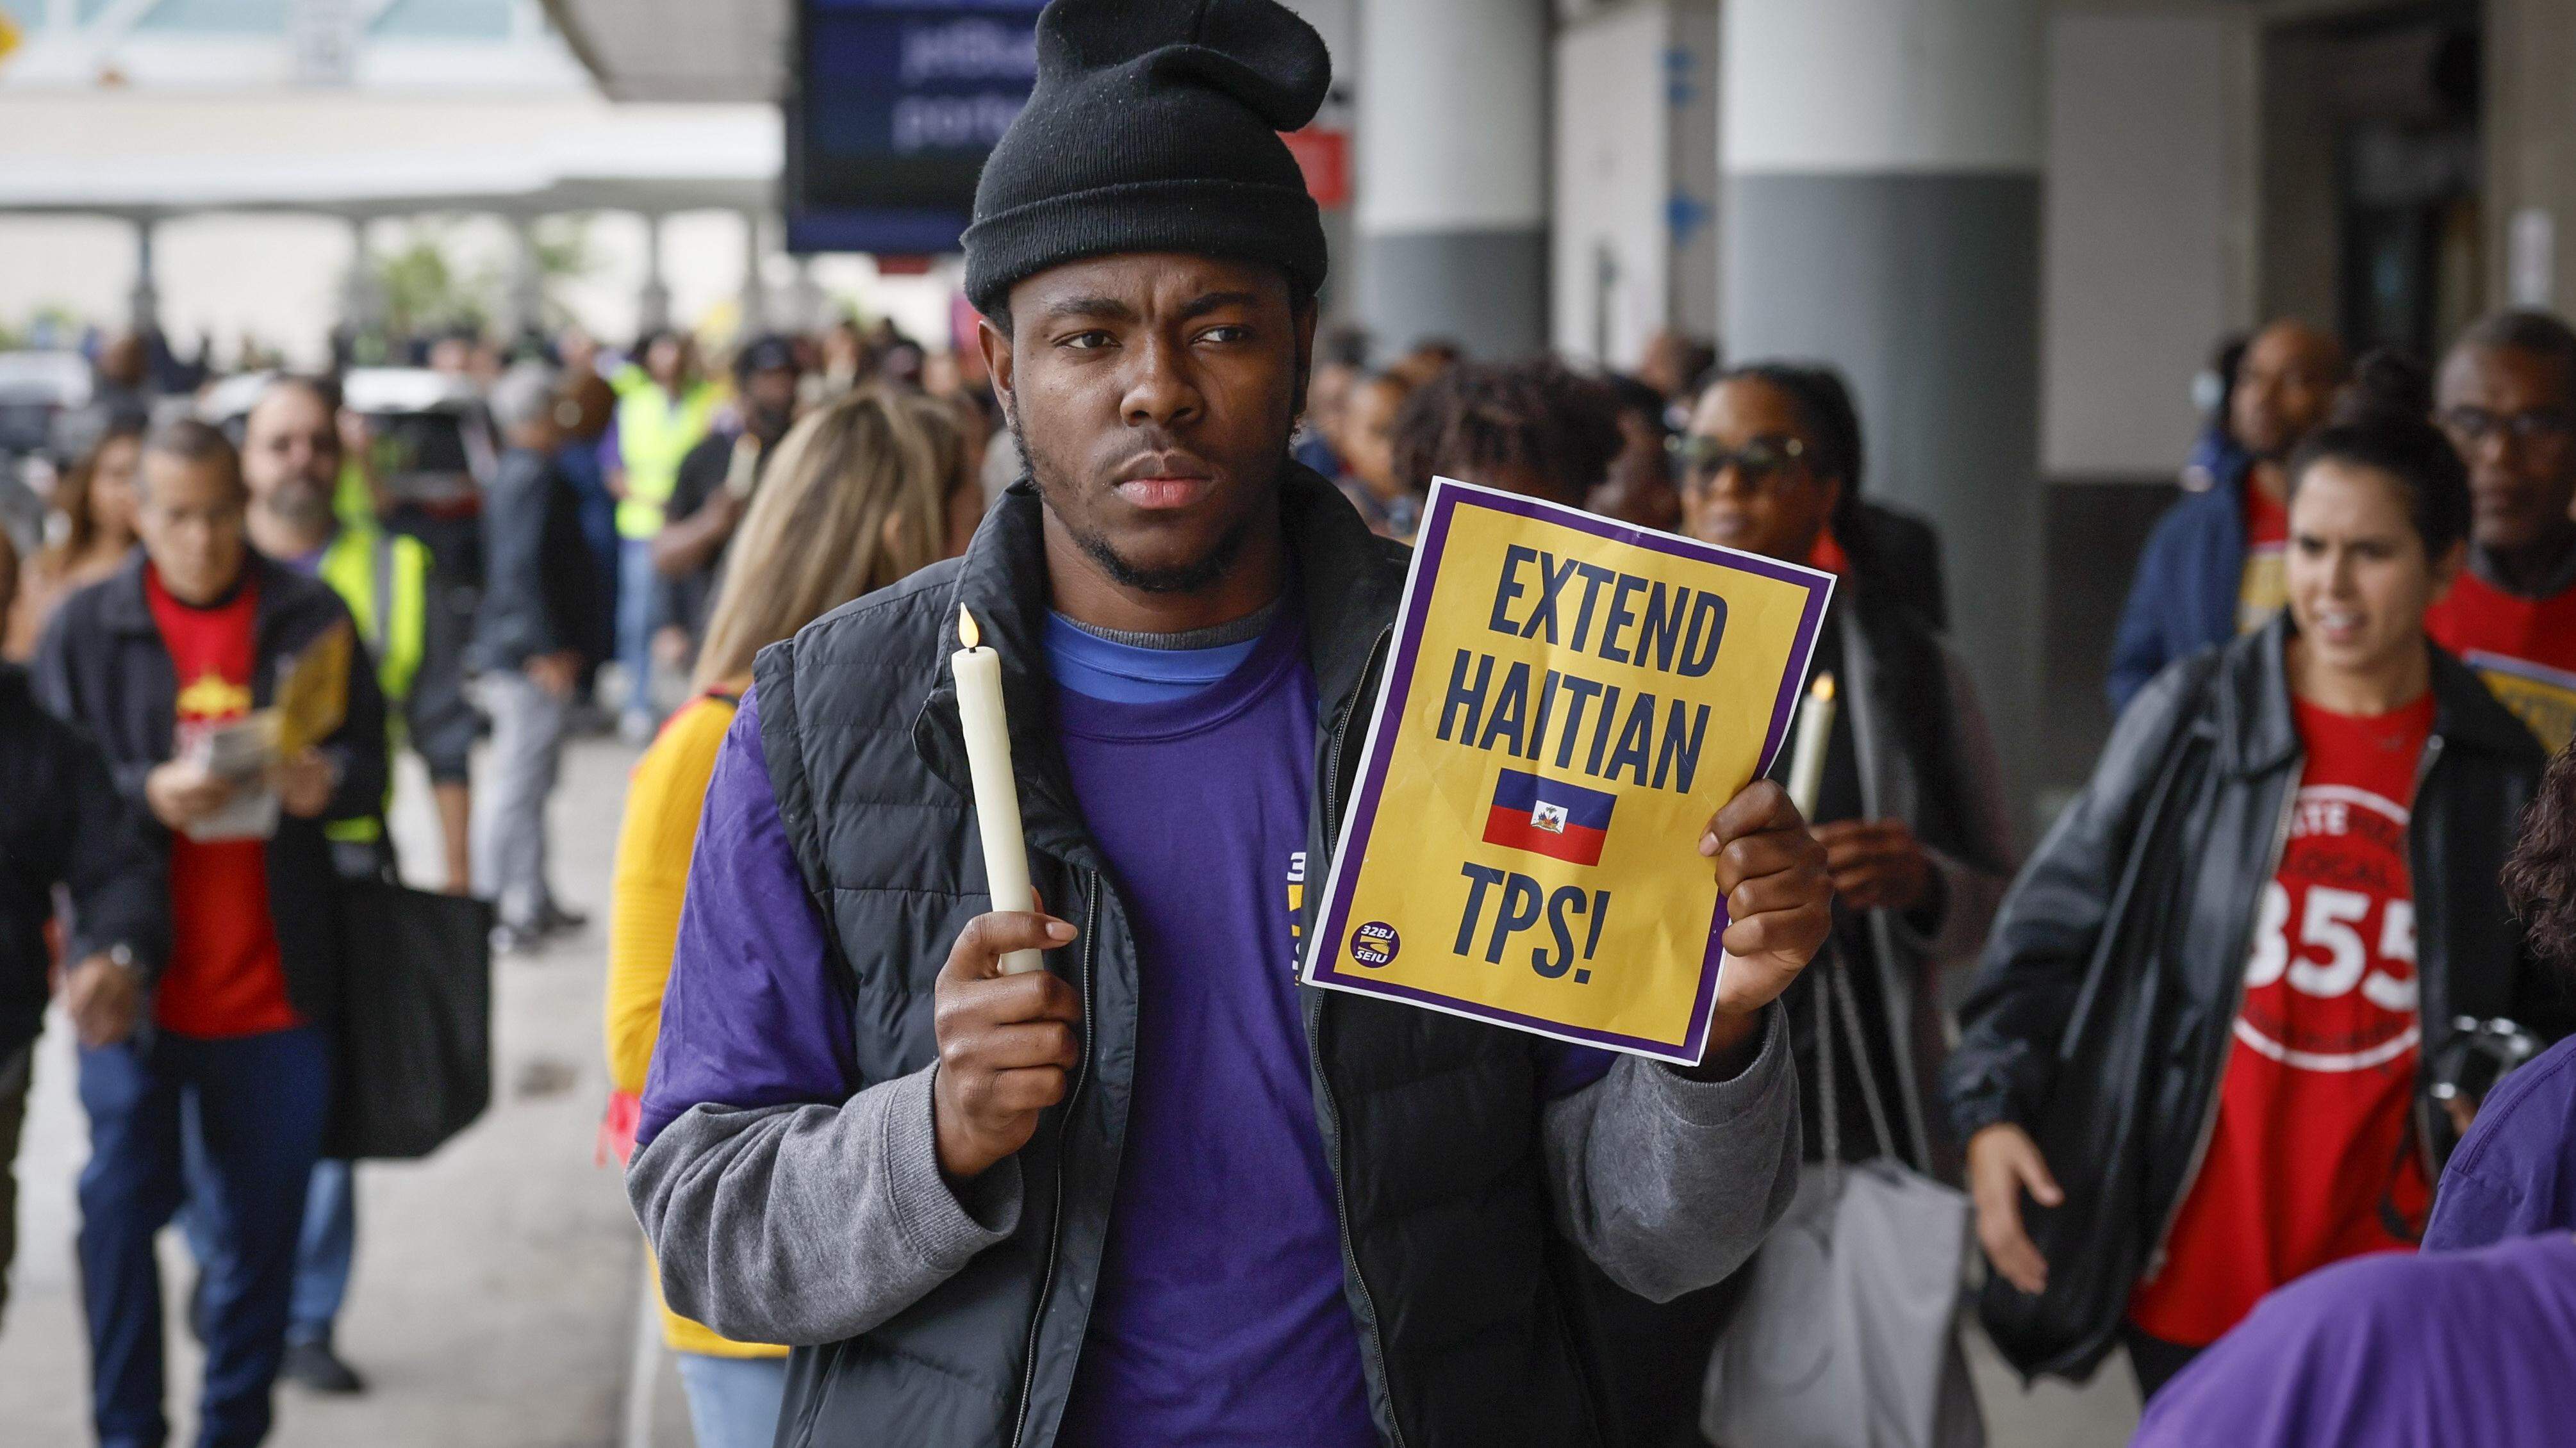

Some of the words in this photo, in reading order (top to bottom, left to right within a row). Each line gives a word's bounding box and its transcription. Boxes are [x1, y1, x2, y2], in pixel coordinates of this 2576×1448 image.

[1489, 543, 1728, 678] EXTEND
[1435, 648, 1712, 794] HAITIAN
[1354, 950, 1389, 964] SEIU
[1360, 925, 1395, 940] 32BJ
[1452, 862, 1611, 985] TPS!
